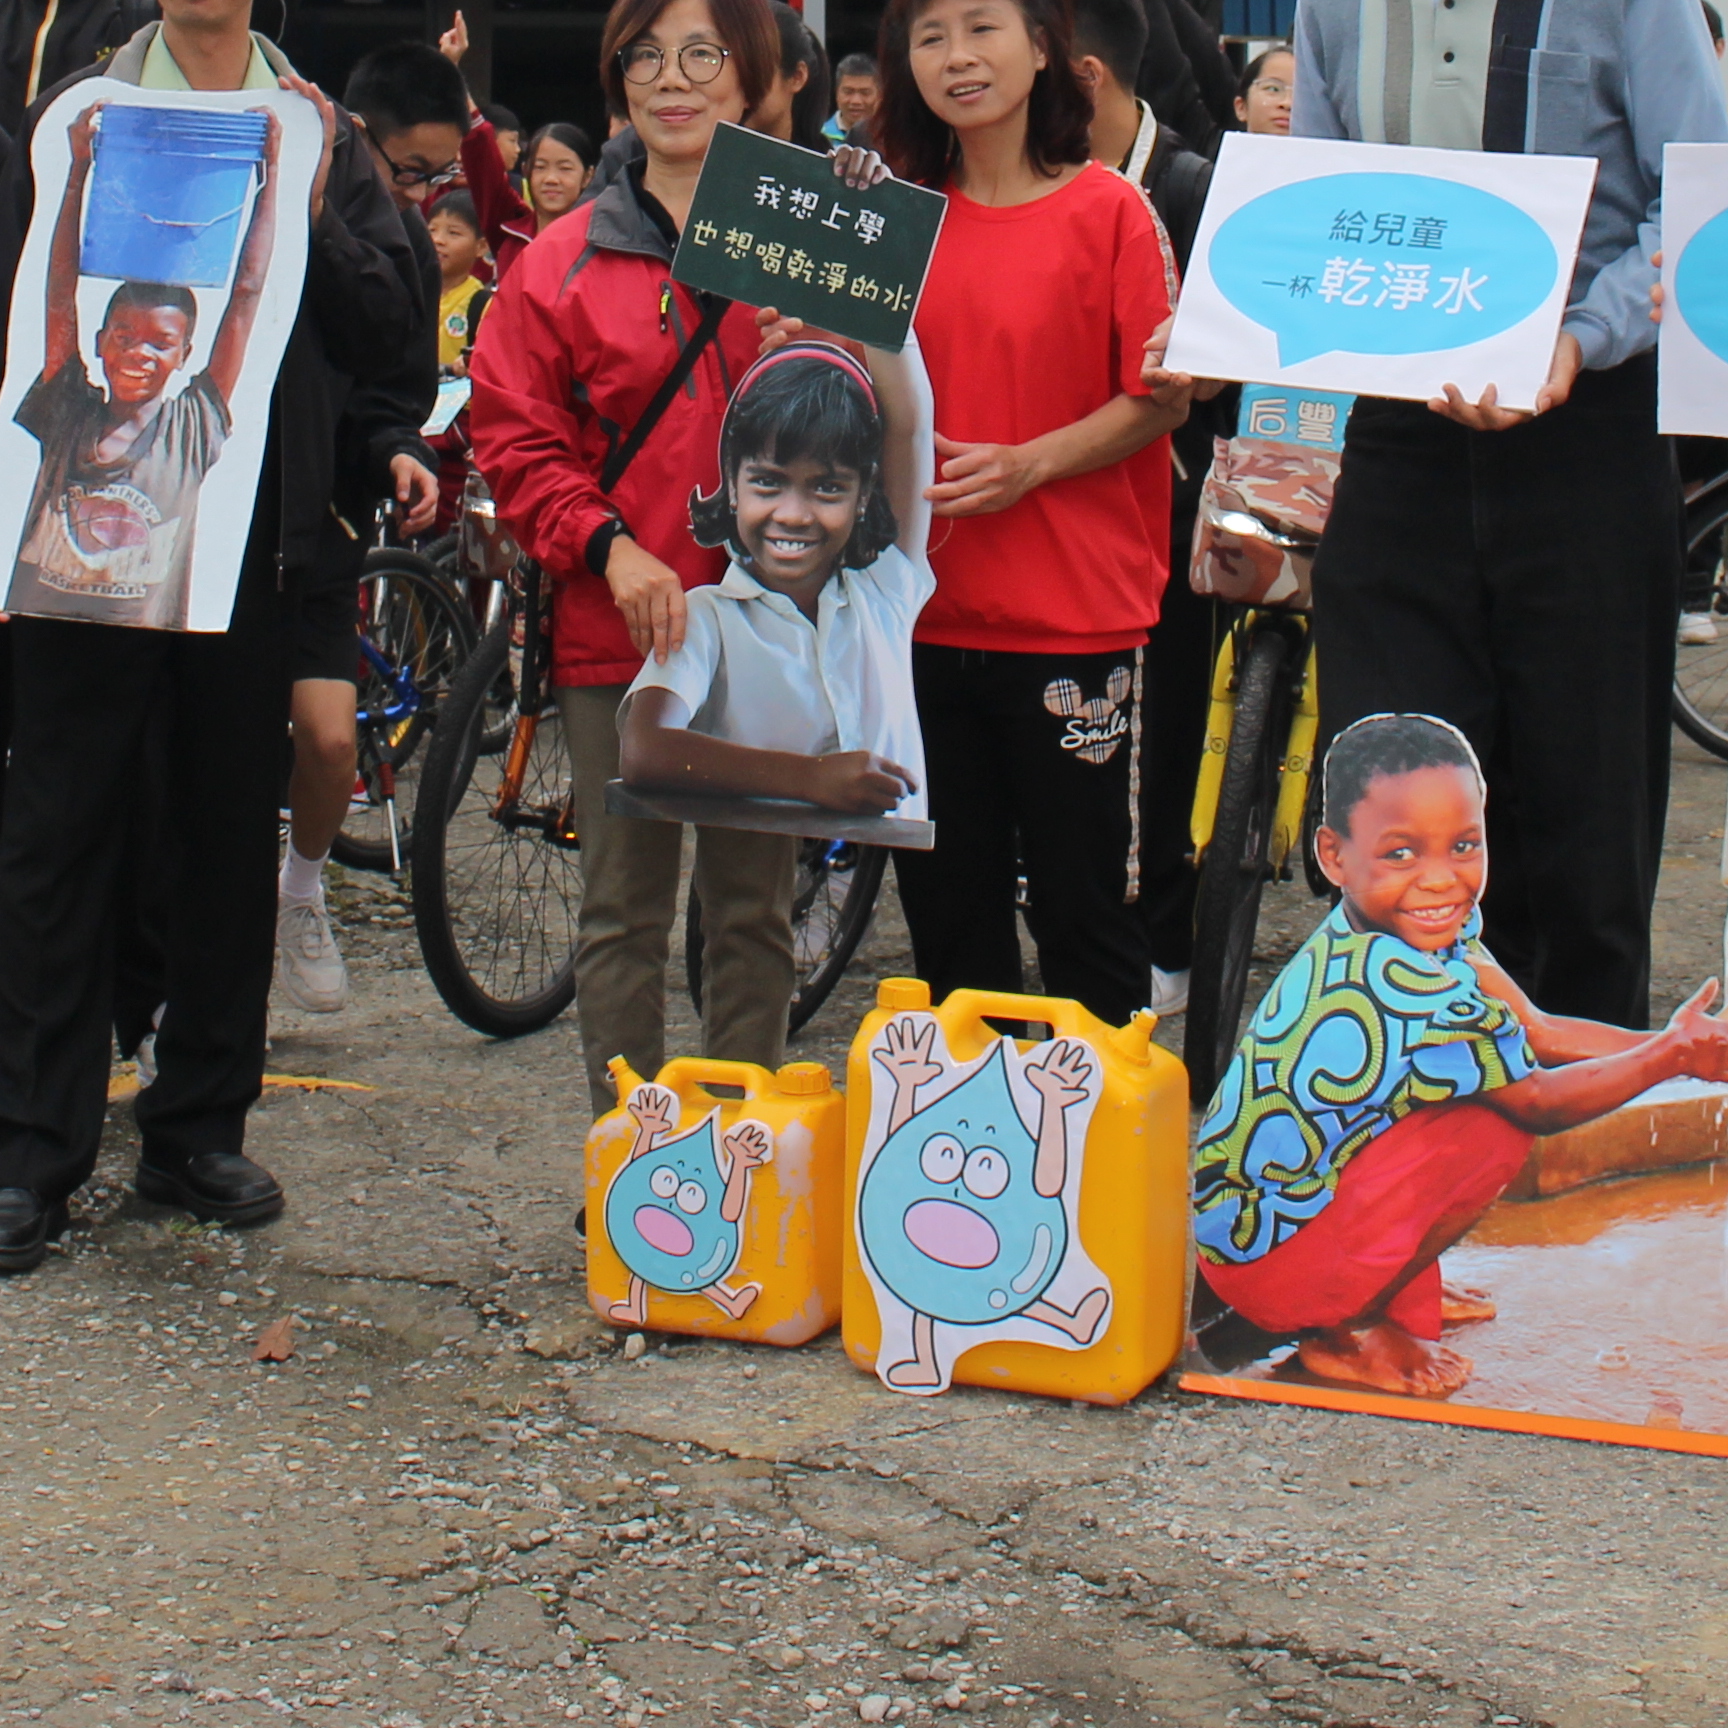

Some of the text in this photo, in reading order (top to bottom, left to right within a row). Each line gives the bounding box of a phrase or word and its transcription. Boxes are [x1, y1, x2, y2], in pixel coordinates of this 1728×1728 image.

[753, 176, 886, 245] 我想上學
[1328, 208, 1449, 251] 給兒童
[693, 219, 913, 311] 也想喝乾淨的水
[1060, 709, 1129, 749] Smile
